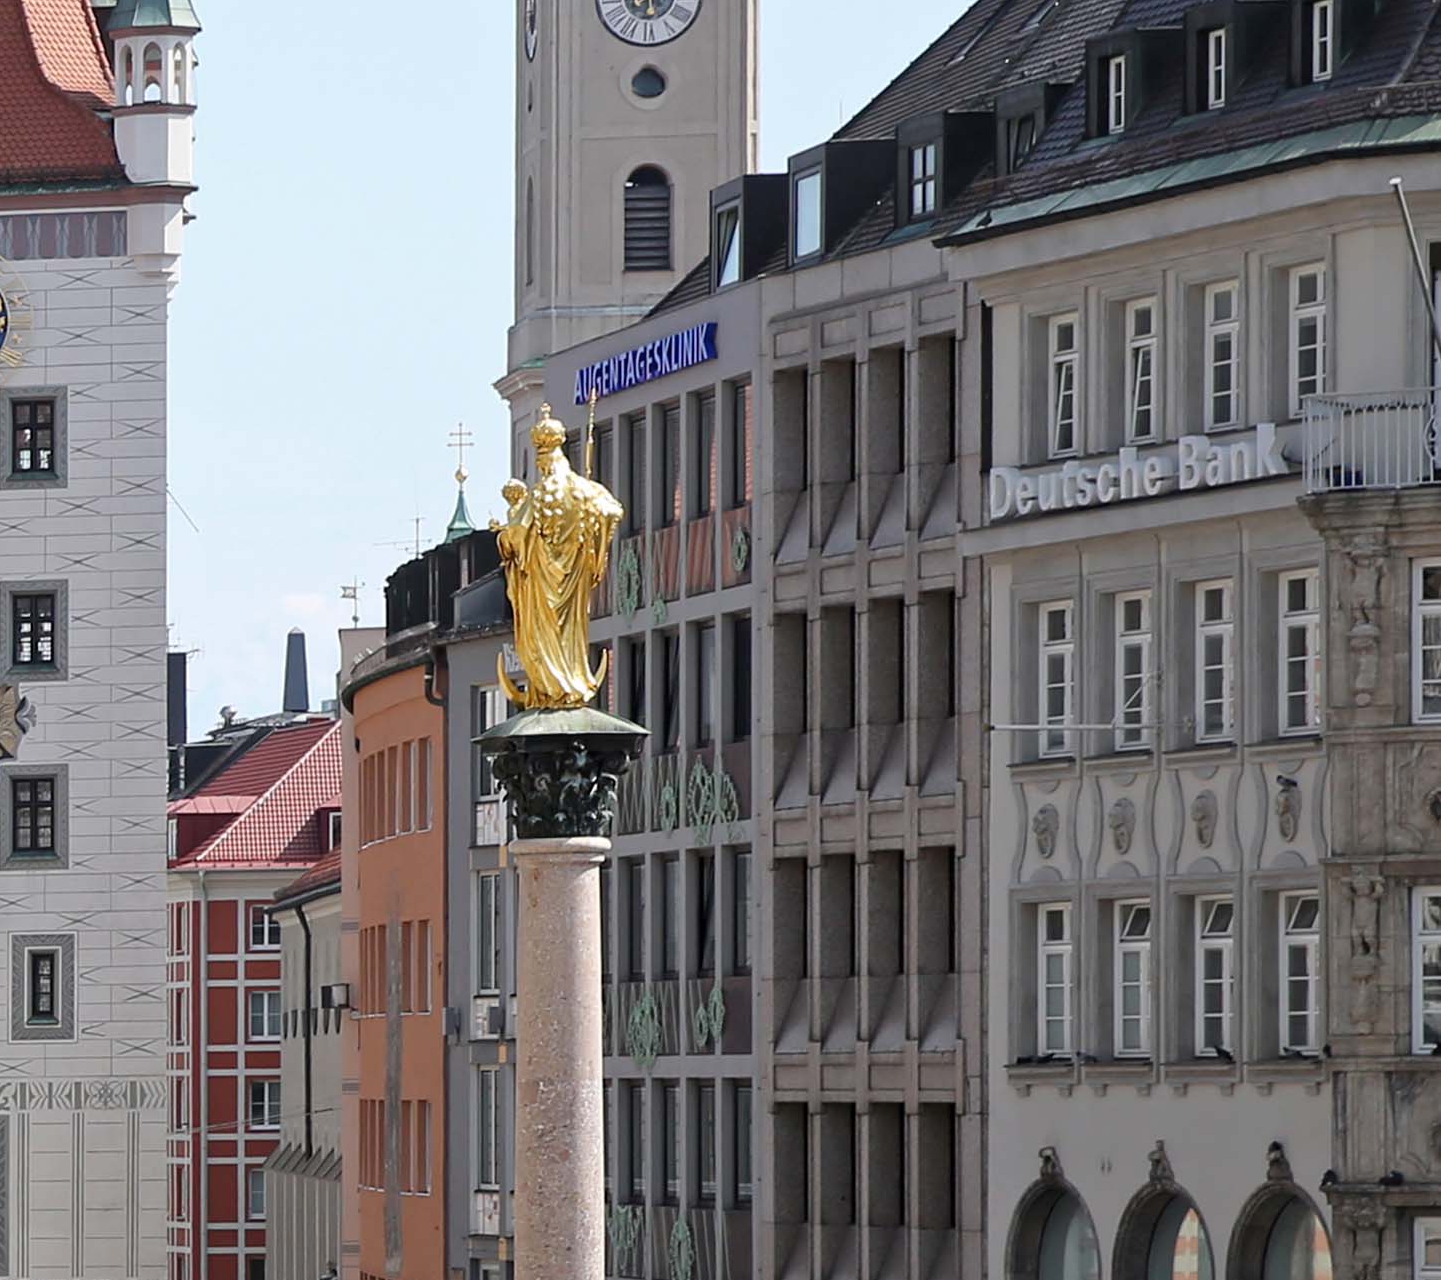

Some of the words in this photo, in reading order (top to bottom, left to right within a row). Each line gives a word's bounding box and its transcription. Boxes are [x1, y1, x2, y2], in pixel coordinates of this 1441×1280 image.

[574, 322, 708, 405] AUGENTAGESKLINIK
[990, 446, 1169, 520] Deutsche
[1178, 422, 1289, 490] Bank
